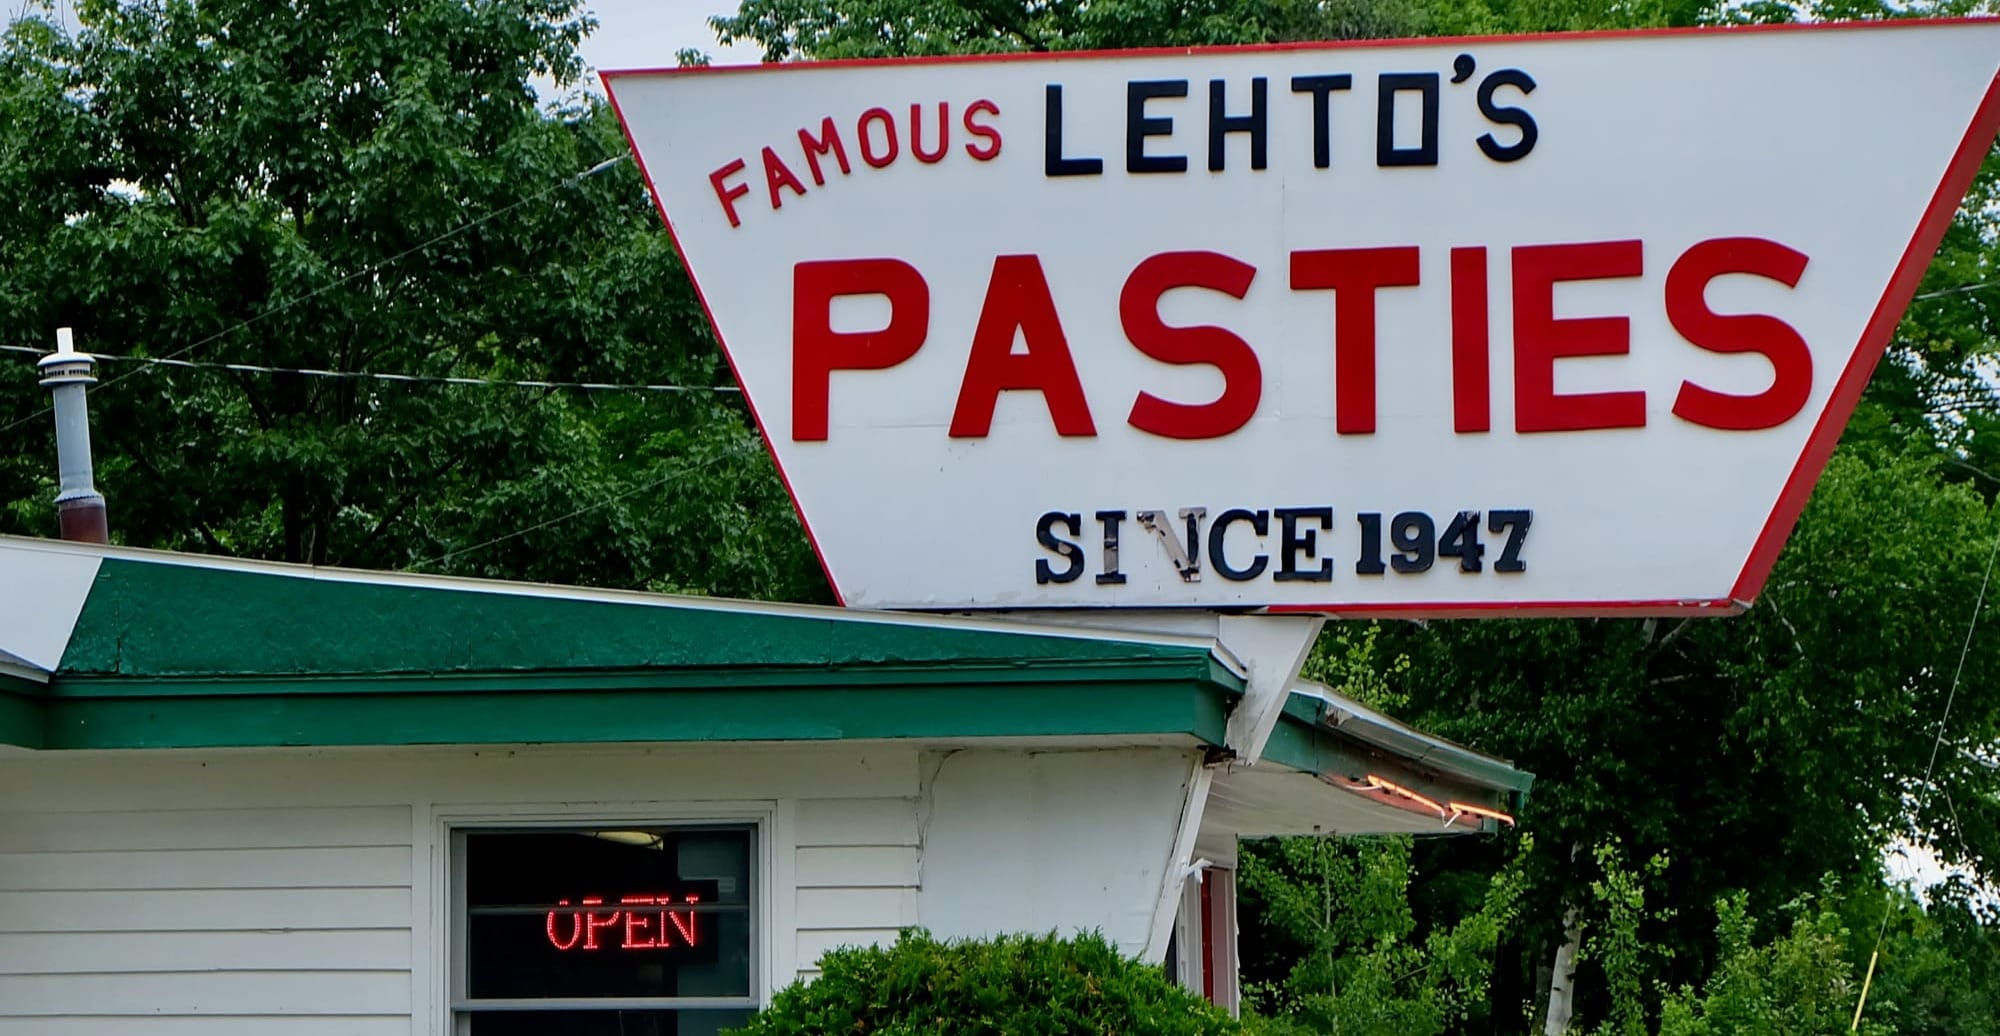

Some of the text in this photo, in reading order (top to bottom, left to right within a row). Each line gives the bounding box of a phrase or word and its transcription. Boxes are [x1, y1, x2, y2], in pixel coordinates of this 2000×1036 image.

[709, 53, 1539, 228] FAMOUS LEHTO'S
[791, 237, 1814, 442] PASTIES
[1036, 508, 1532, 585] SINCE 1947
[547, 895, 699, 950] OPEN
